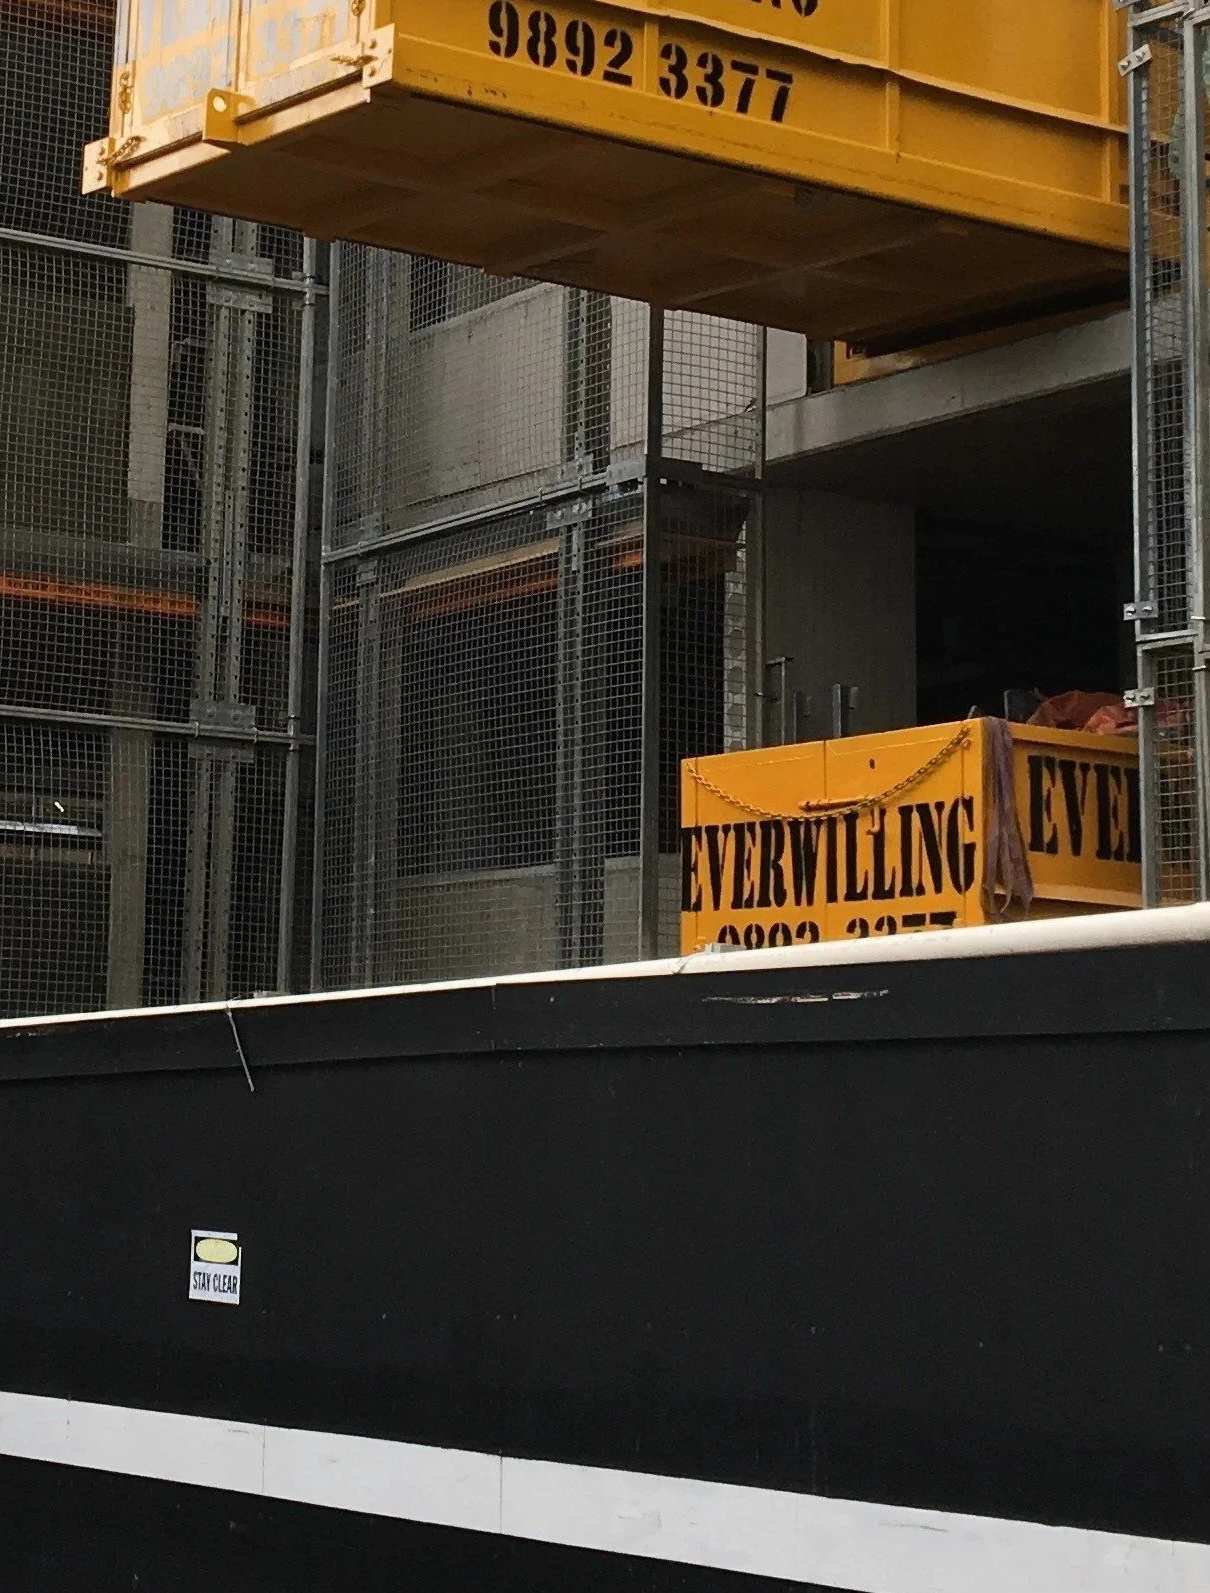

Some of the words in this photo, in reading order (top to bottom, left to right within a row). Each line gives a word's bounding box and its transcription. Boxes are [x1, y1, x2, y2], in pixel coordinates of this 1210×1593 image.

[488, 0, 633, 86] 9892
[659, 43, 793, 123] 3377
[681, 796, 977, 912] EVERWILLING
[193, 1271, 211, 1291] STAY
[214, 1274, 237, 1294] CLEAR
